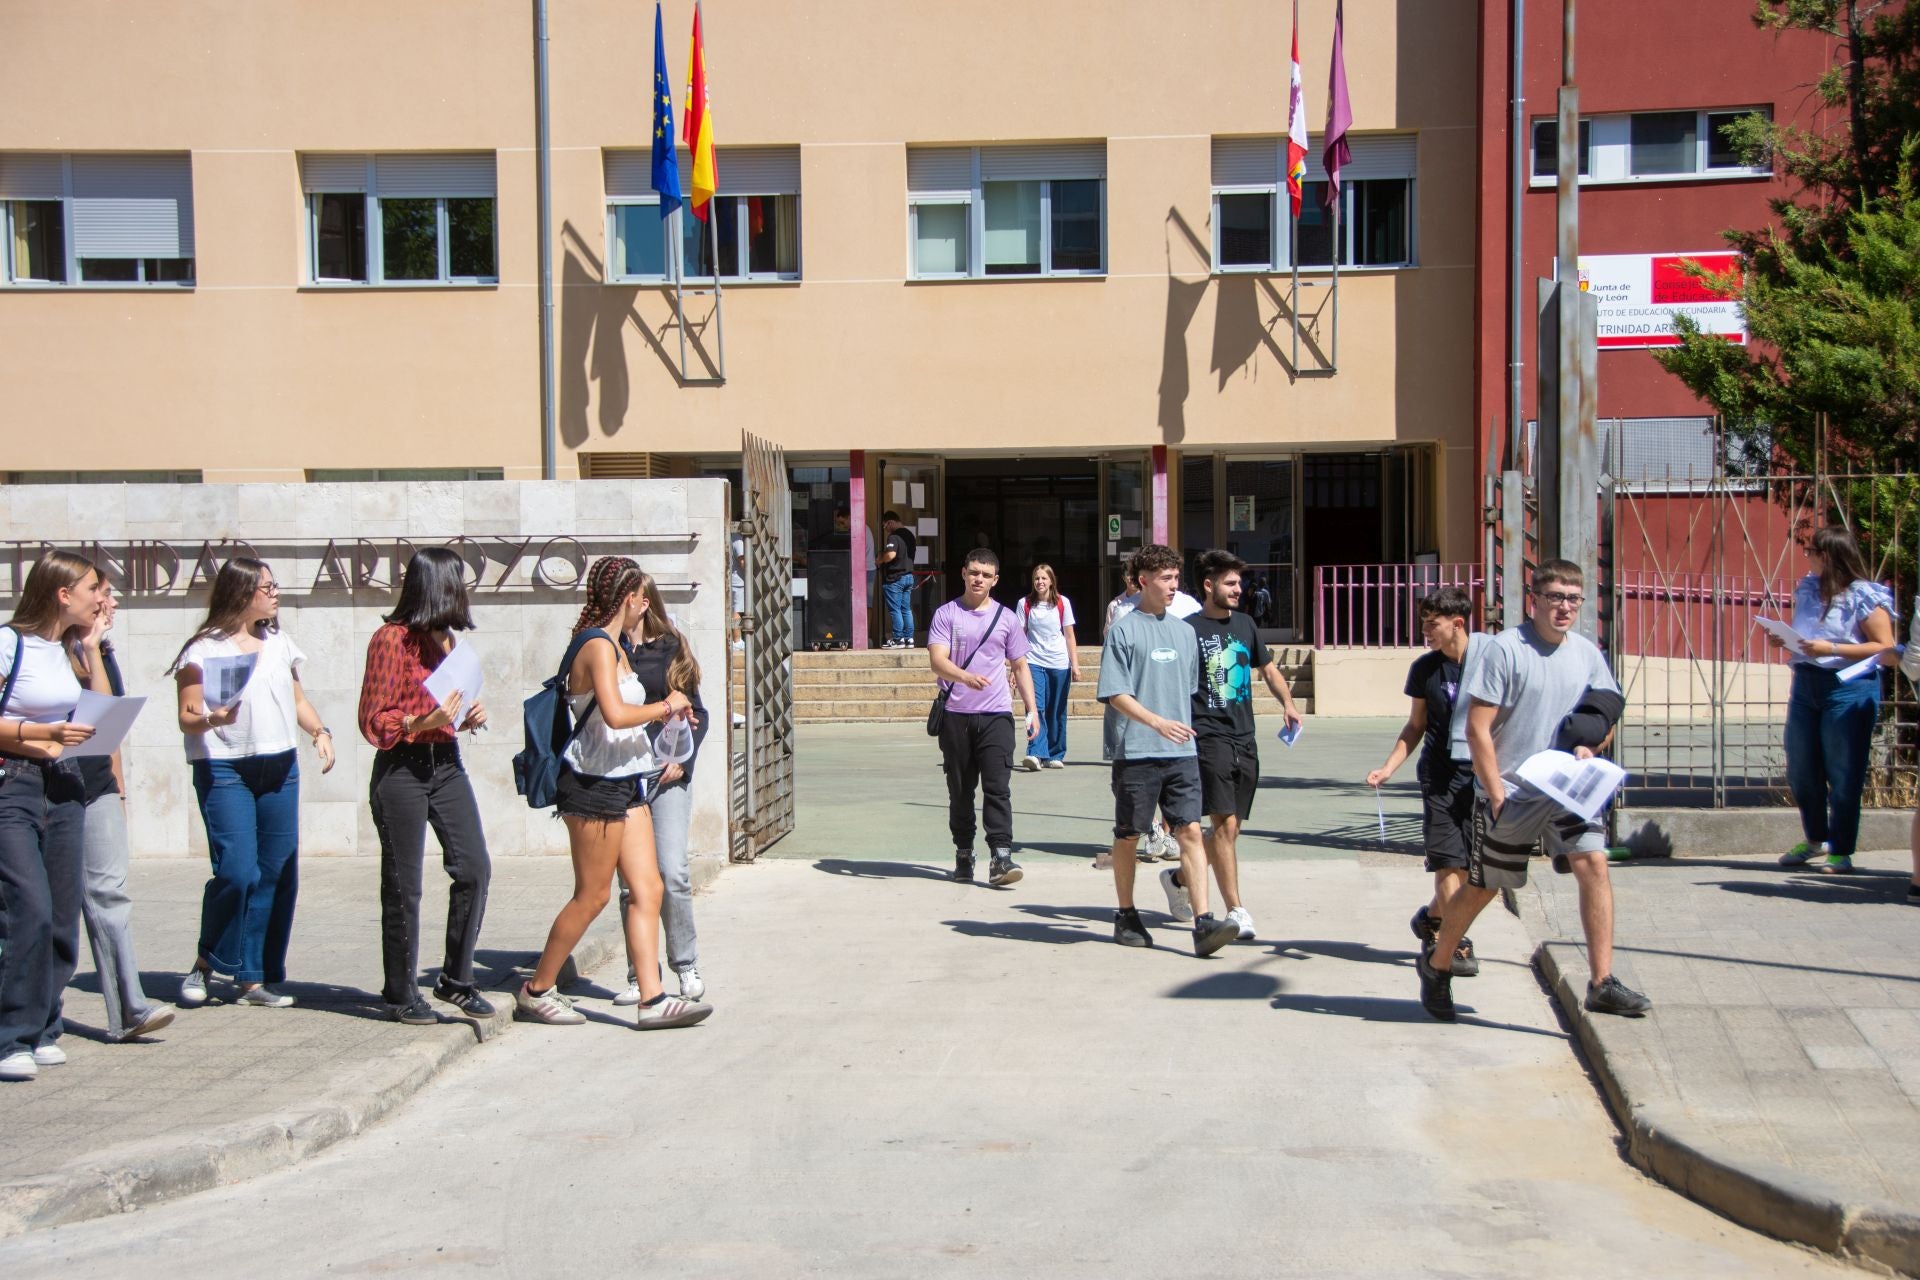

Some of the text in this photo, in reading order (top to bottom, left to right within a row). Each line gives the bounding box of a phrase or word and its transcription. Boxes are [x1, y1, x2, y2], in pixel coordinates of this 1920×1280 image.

[1598, 295, 1604, 303] y
[1629, 307, 1675, 316] EDUCACIÓN
[1599, 324, 1650, 334] TRINIDAD
[5, 540, 260, 591] TNIDA
